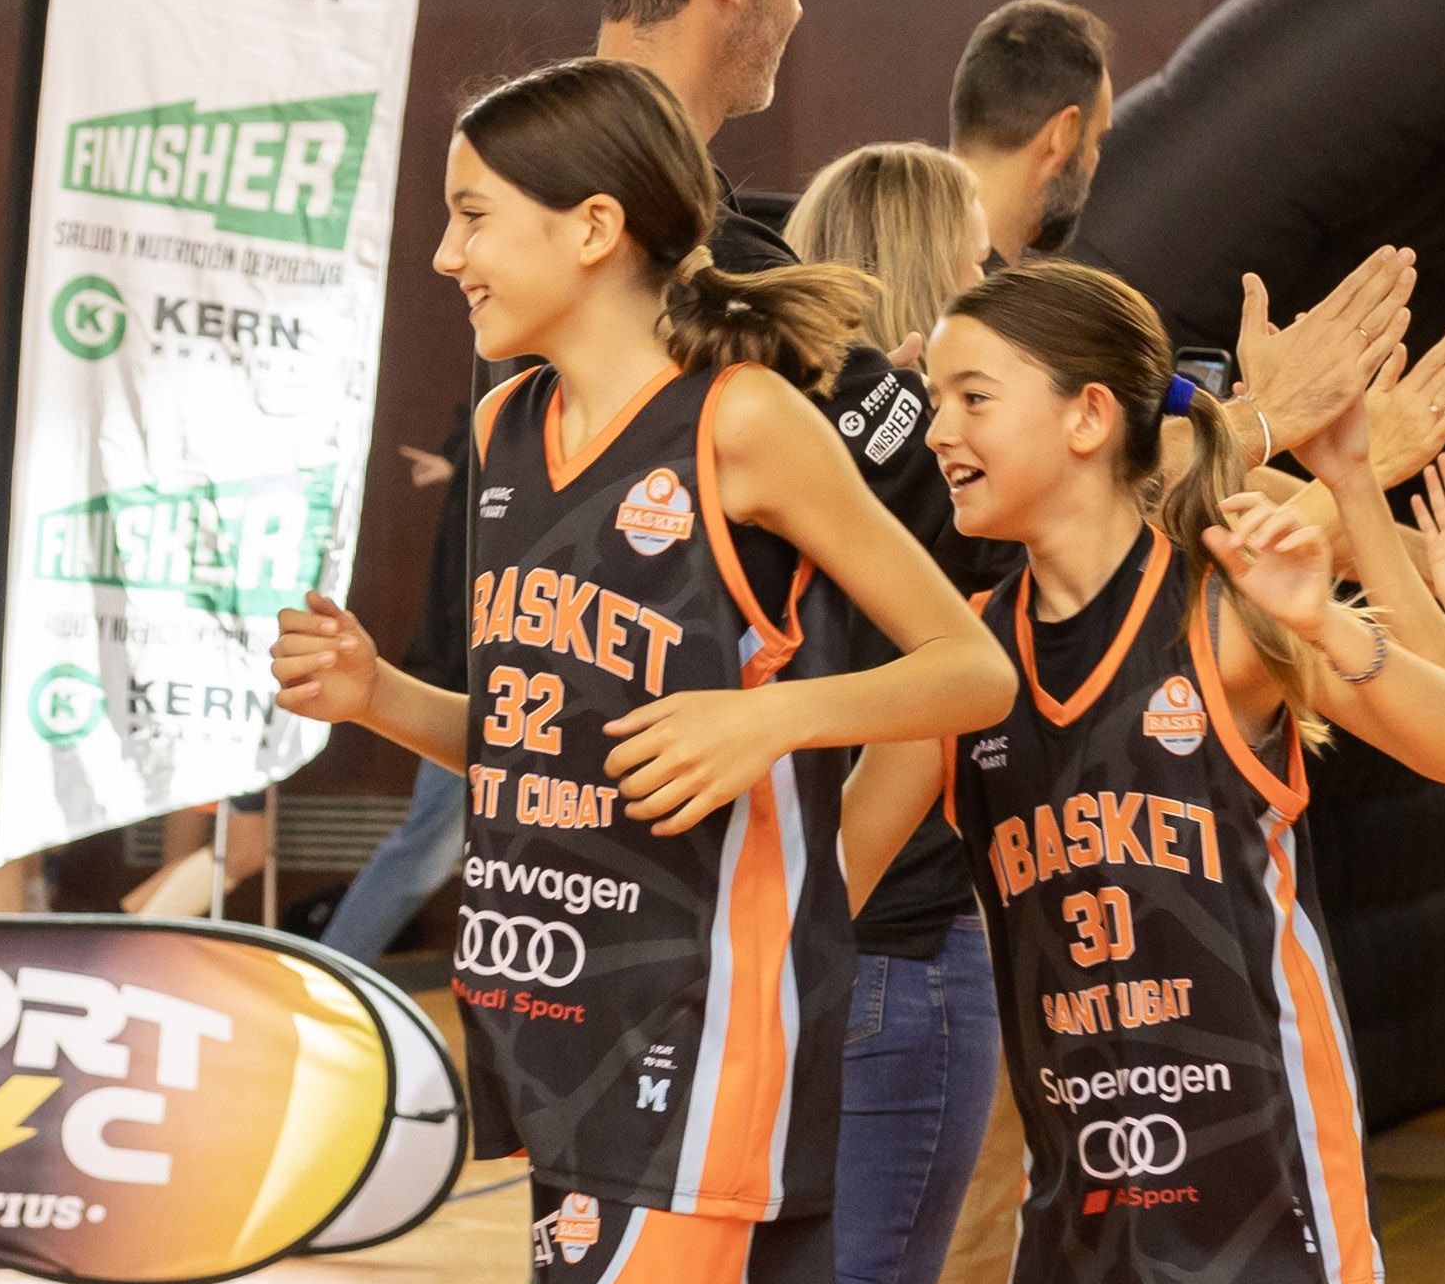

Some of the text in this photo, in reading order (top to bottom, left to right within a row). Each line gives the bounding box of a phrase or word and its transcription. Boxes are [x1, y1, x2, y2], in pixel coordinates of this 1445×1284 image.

[70, 118, 349, 218] FINISHER
[153, 295, 301, 351] KERN
[860, 372, 898, 413] KERN
[868, 398, 918, 460] FINISHER
[126, 673, 277, 726] KERN
[483, 665, 565, 756] 32
[516, 772, 619, 829] CUGAT
[988, 791, 1224, 908] BASKET
[462, 854, 641, 915] erwagen
[1062, 885, 1136, 968] 30
[512, 990, 585, 1025] Sport
[1115, 978, 1193, 1029] UGAT
[636, 1074, 673, 1113] M
[1127, 1185, 1200, 1209] Sport
